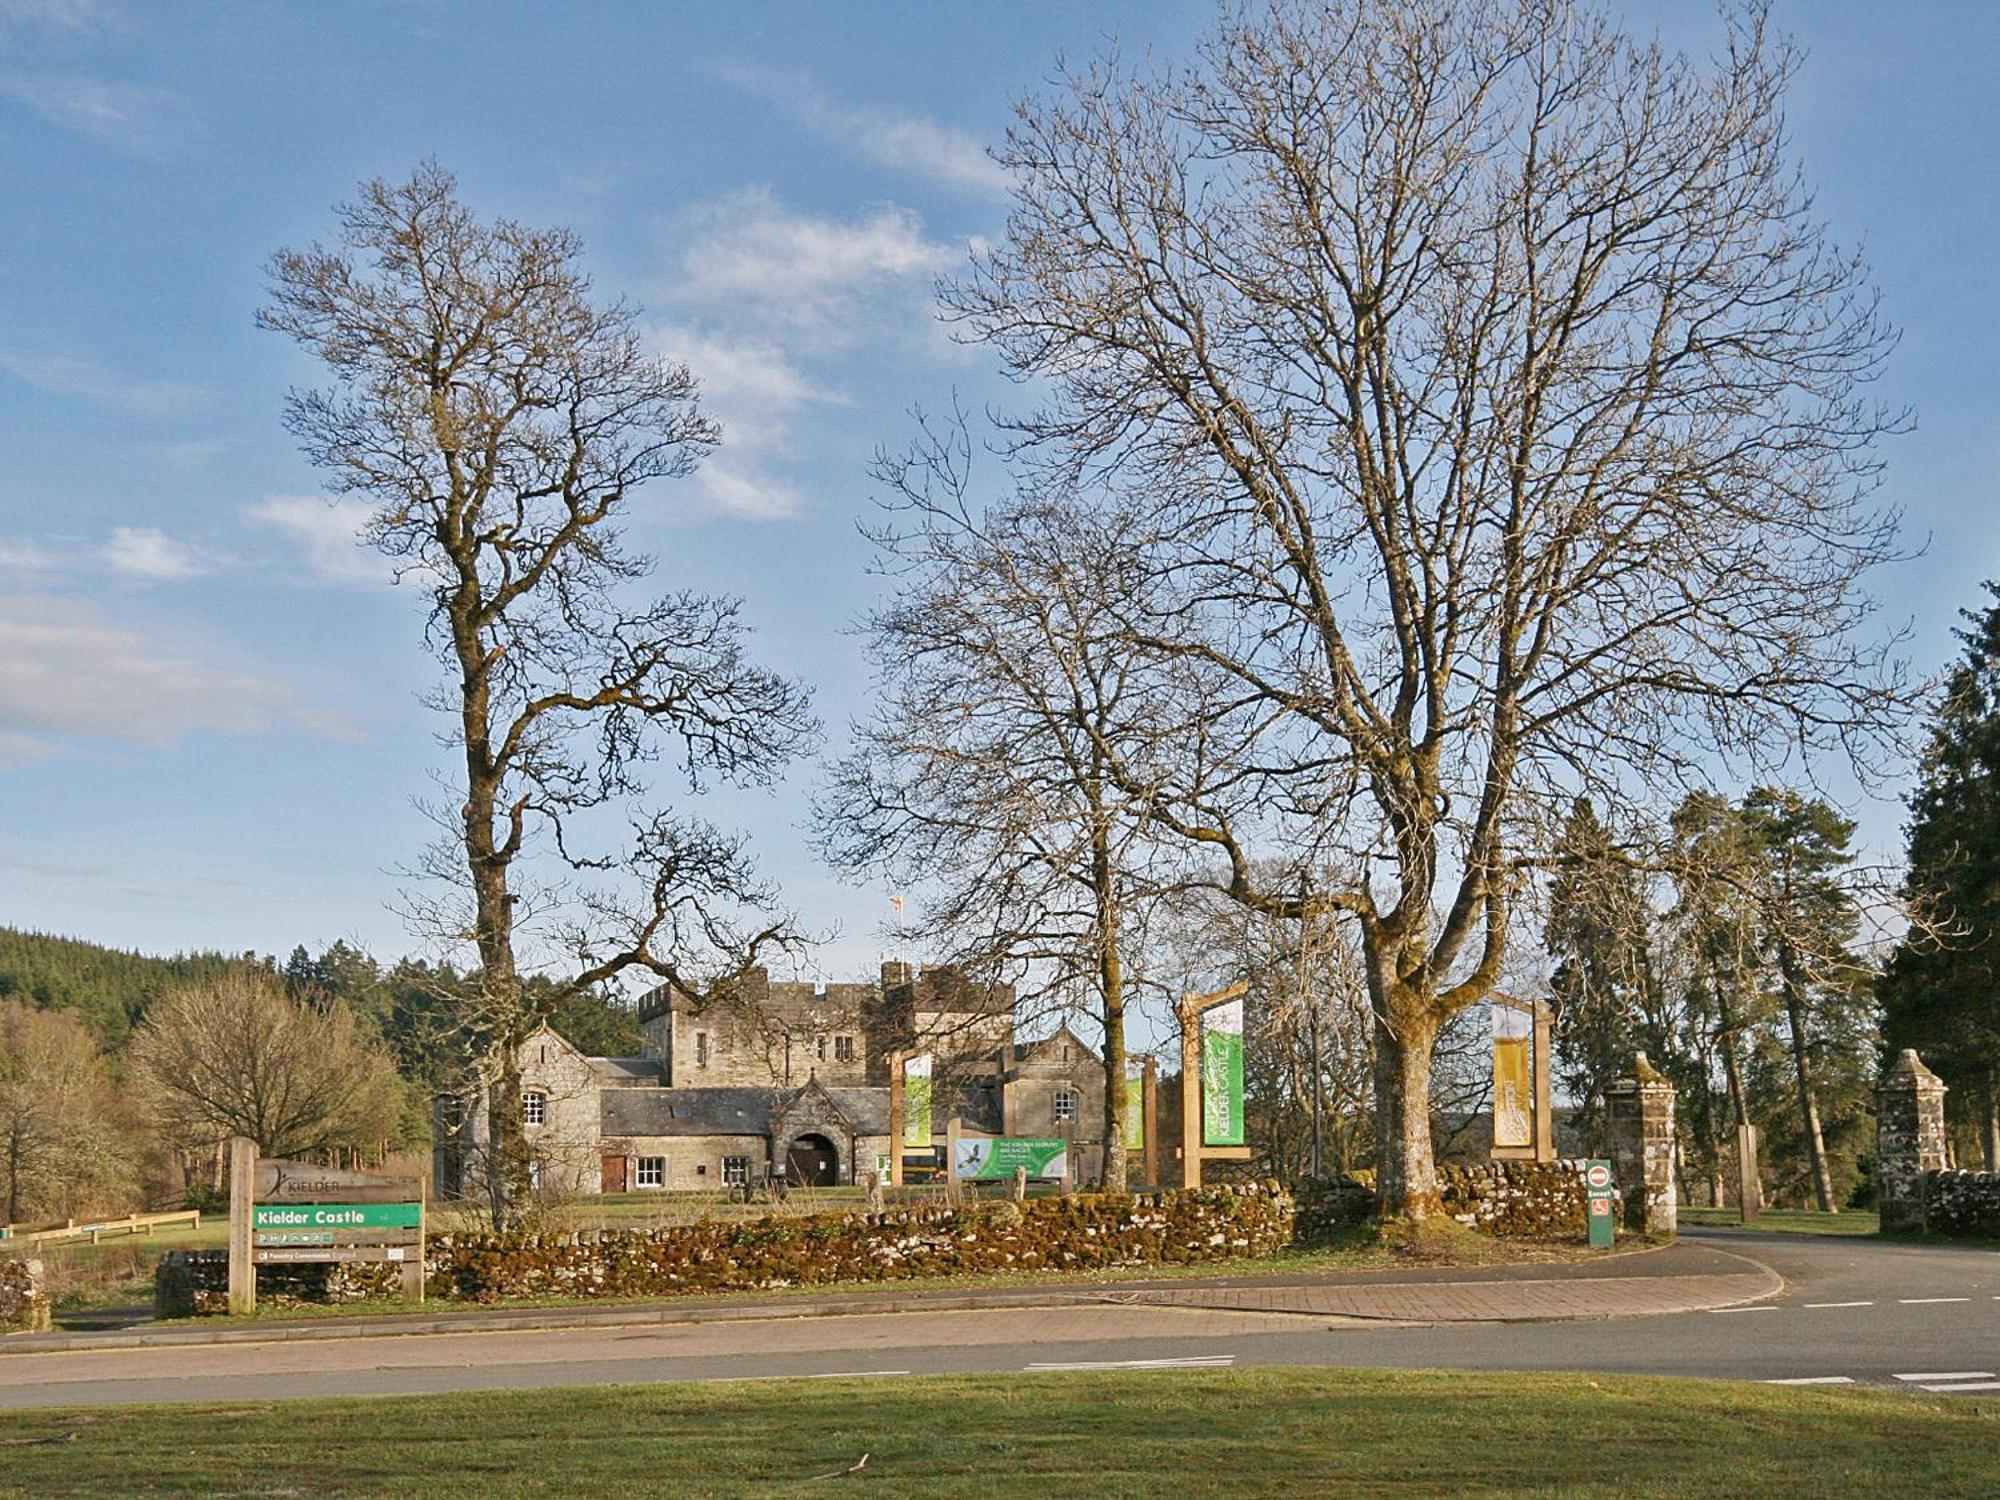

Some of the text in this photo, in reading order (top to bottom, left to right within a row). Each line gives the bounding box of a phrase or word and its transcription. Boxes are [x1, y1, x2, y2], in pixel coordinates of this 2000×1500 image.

[1218, 1048, 1229, 1090] CASTLE
[288, 1181, 340, 1193] KIELDER
[258, 1210, 365, 1224] Kielder Castle
